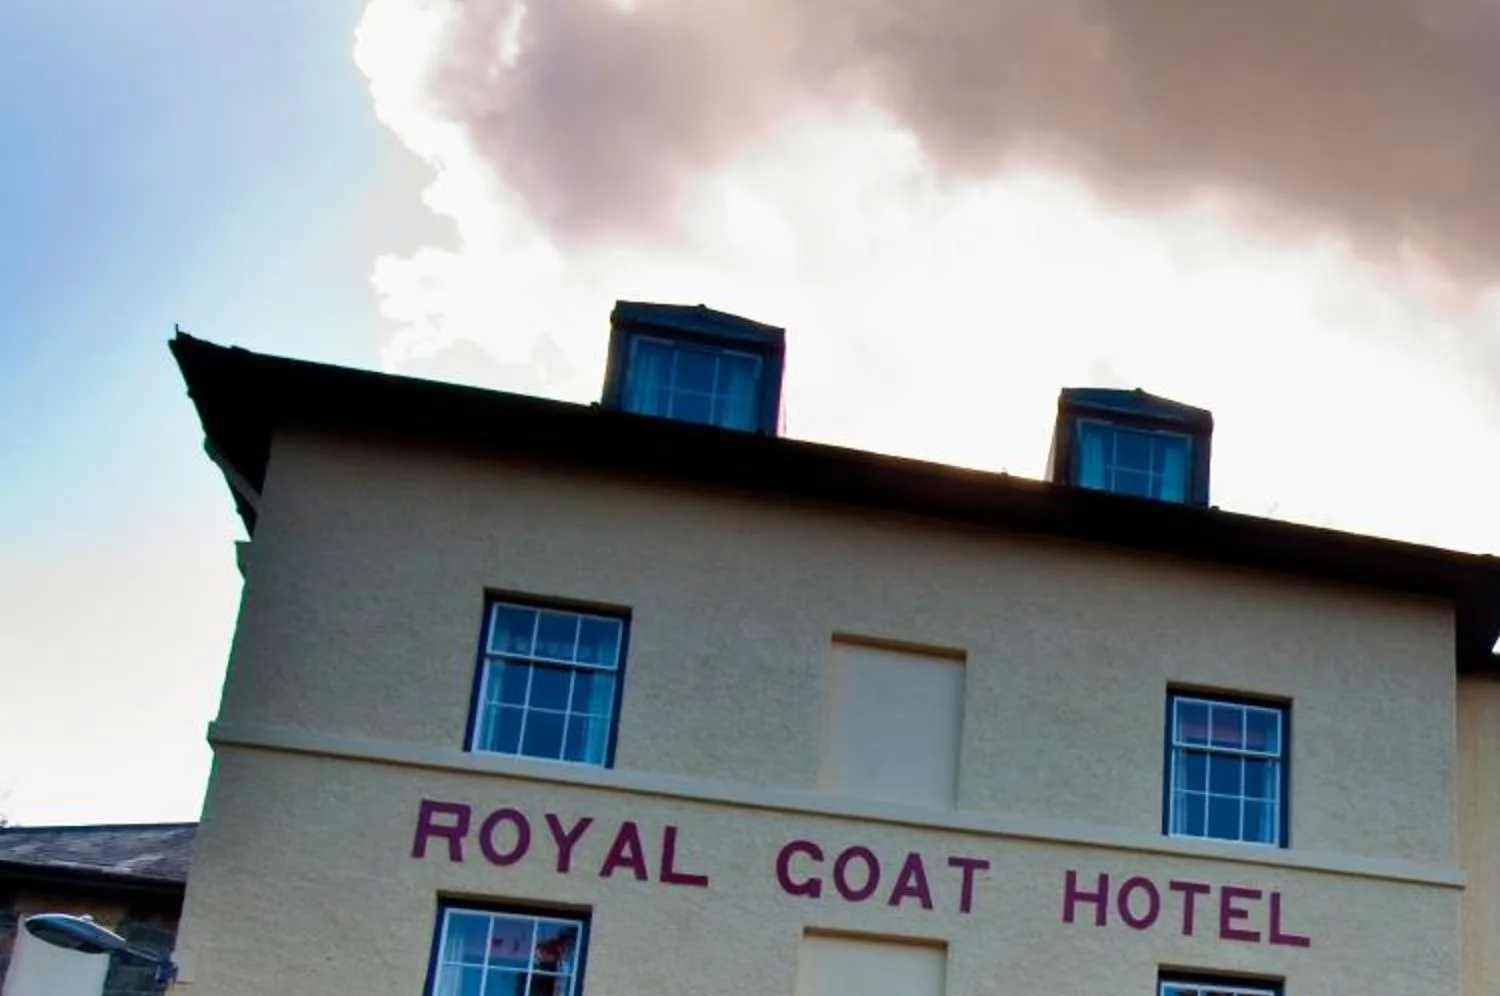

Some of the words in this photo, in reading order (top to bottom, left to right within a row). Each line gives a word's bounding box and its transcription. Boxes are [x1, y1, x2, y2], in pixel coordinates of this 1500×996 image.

[411, 799, 709, 888] ROYAL
[776, 841, 989, 914] GOAT
[1063, 870, 1311, 947] HOTEL
